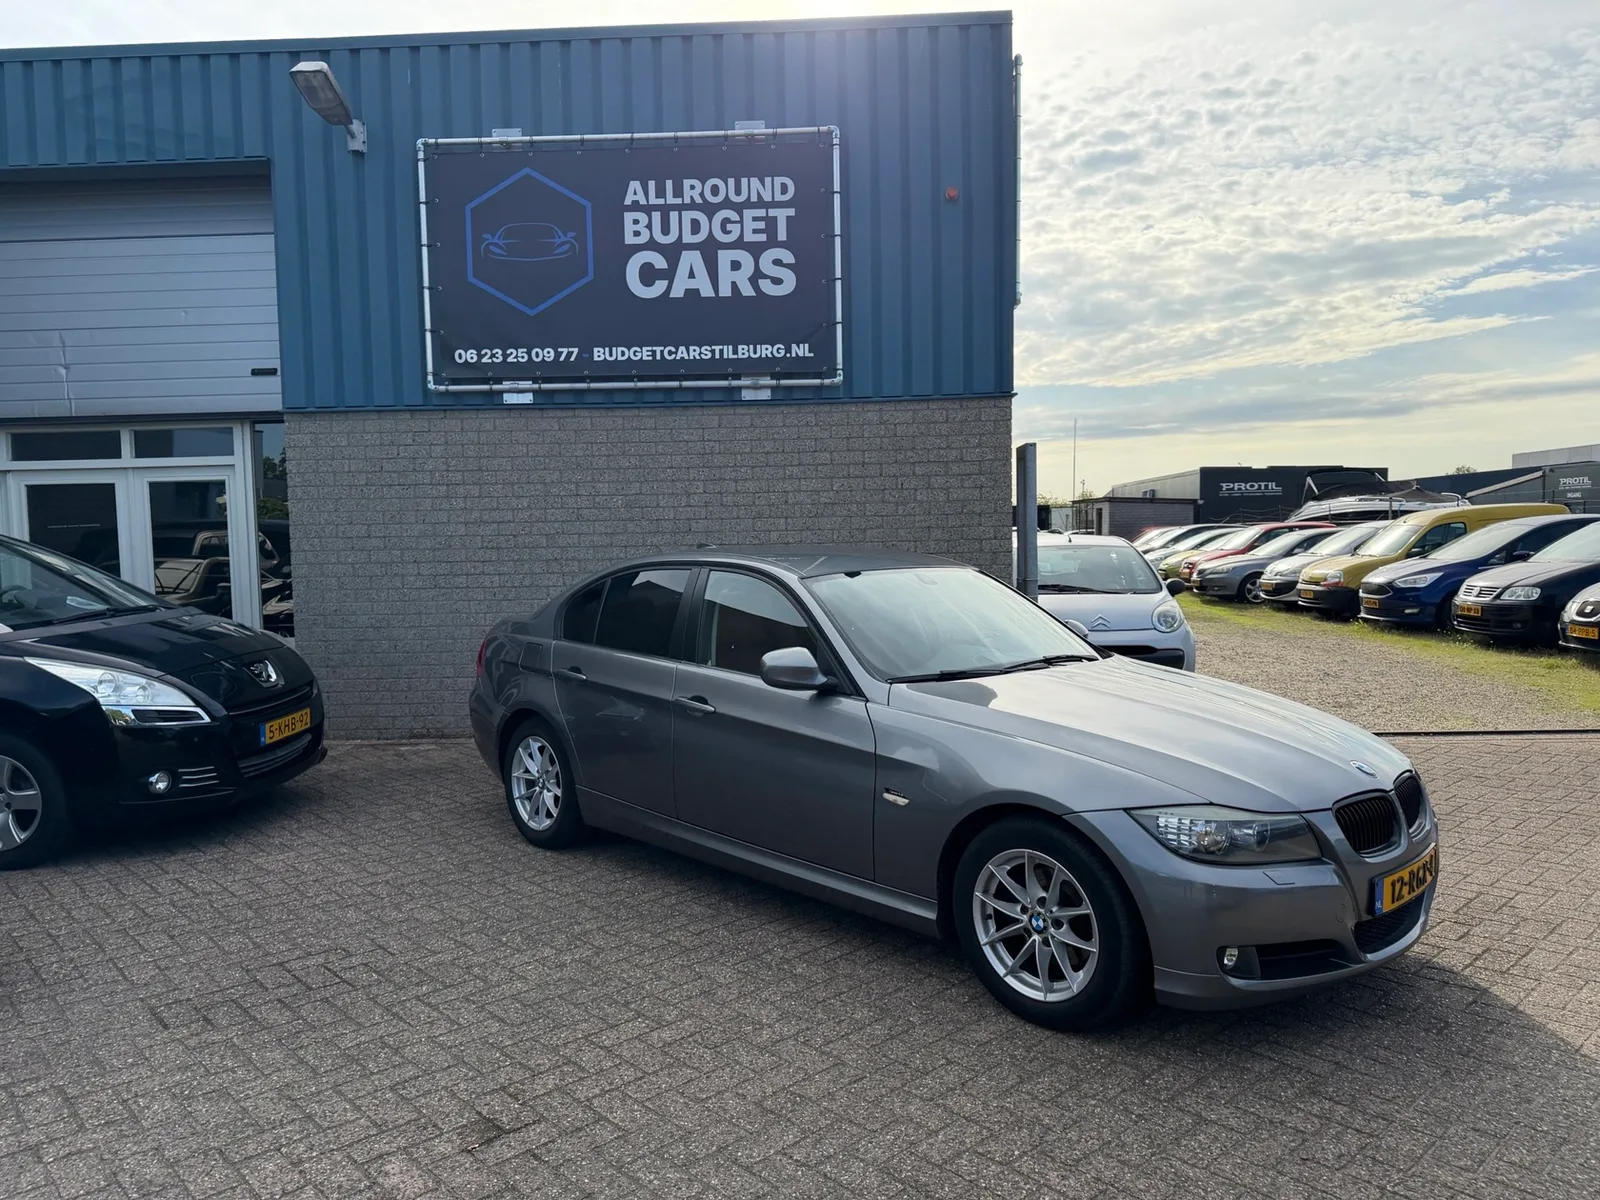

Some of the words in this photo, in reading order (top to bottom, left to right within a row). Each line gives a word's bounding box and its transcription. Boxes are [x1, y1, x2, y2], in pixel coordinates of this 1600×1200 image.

[624, 177, 796, 206] ALLROUND
[624, 208, 796, 245] BUDGET
[625, 248, 797, 299] CARS
[454, 349, 478, 364] 06
[480, 348, 504, 363] 23
[506, 348, 529, 363] 25
[531, 347, 555, 363] 09
[557, 347, 579, 362] 77
[593, 343, 814, 361] BUDGETCARSTILBURG.NL
[1219, 482, 1283, 491] PROTIL
[1558, 476, 1592, 485] PROTIL
[268, 711, 310, 740] 5-KHB-92
